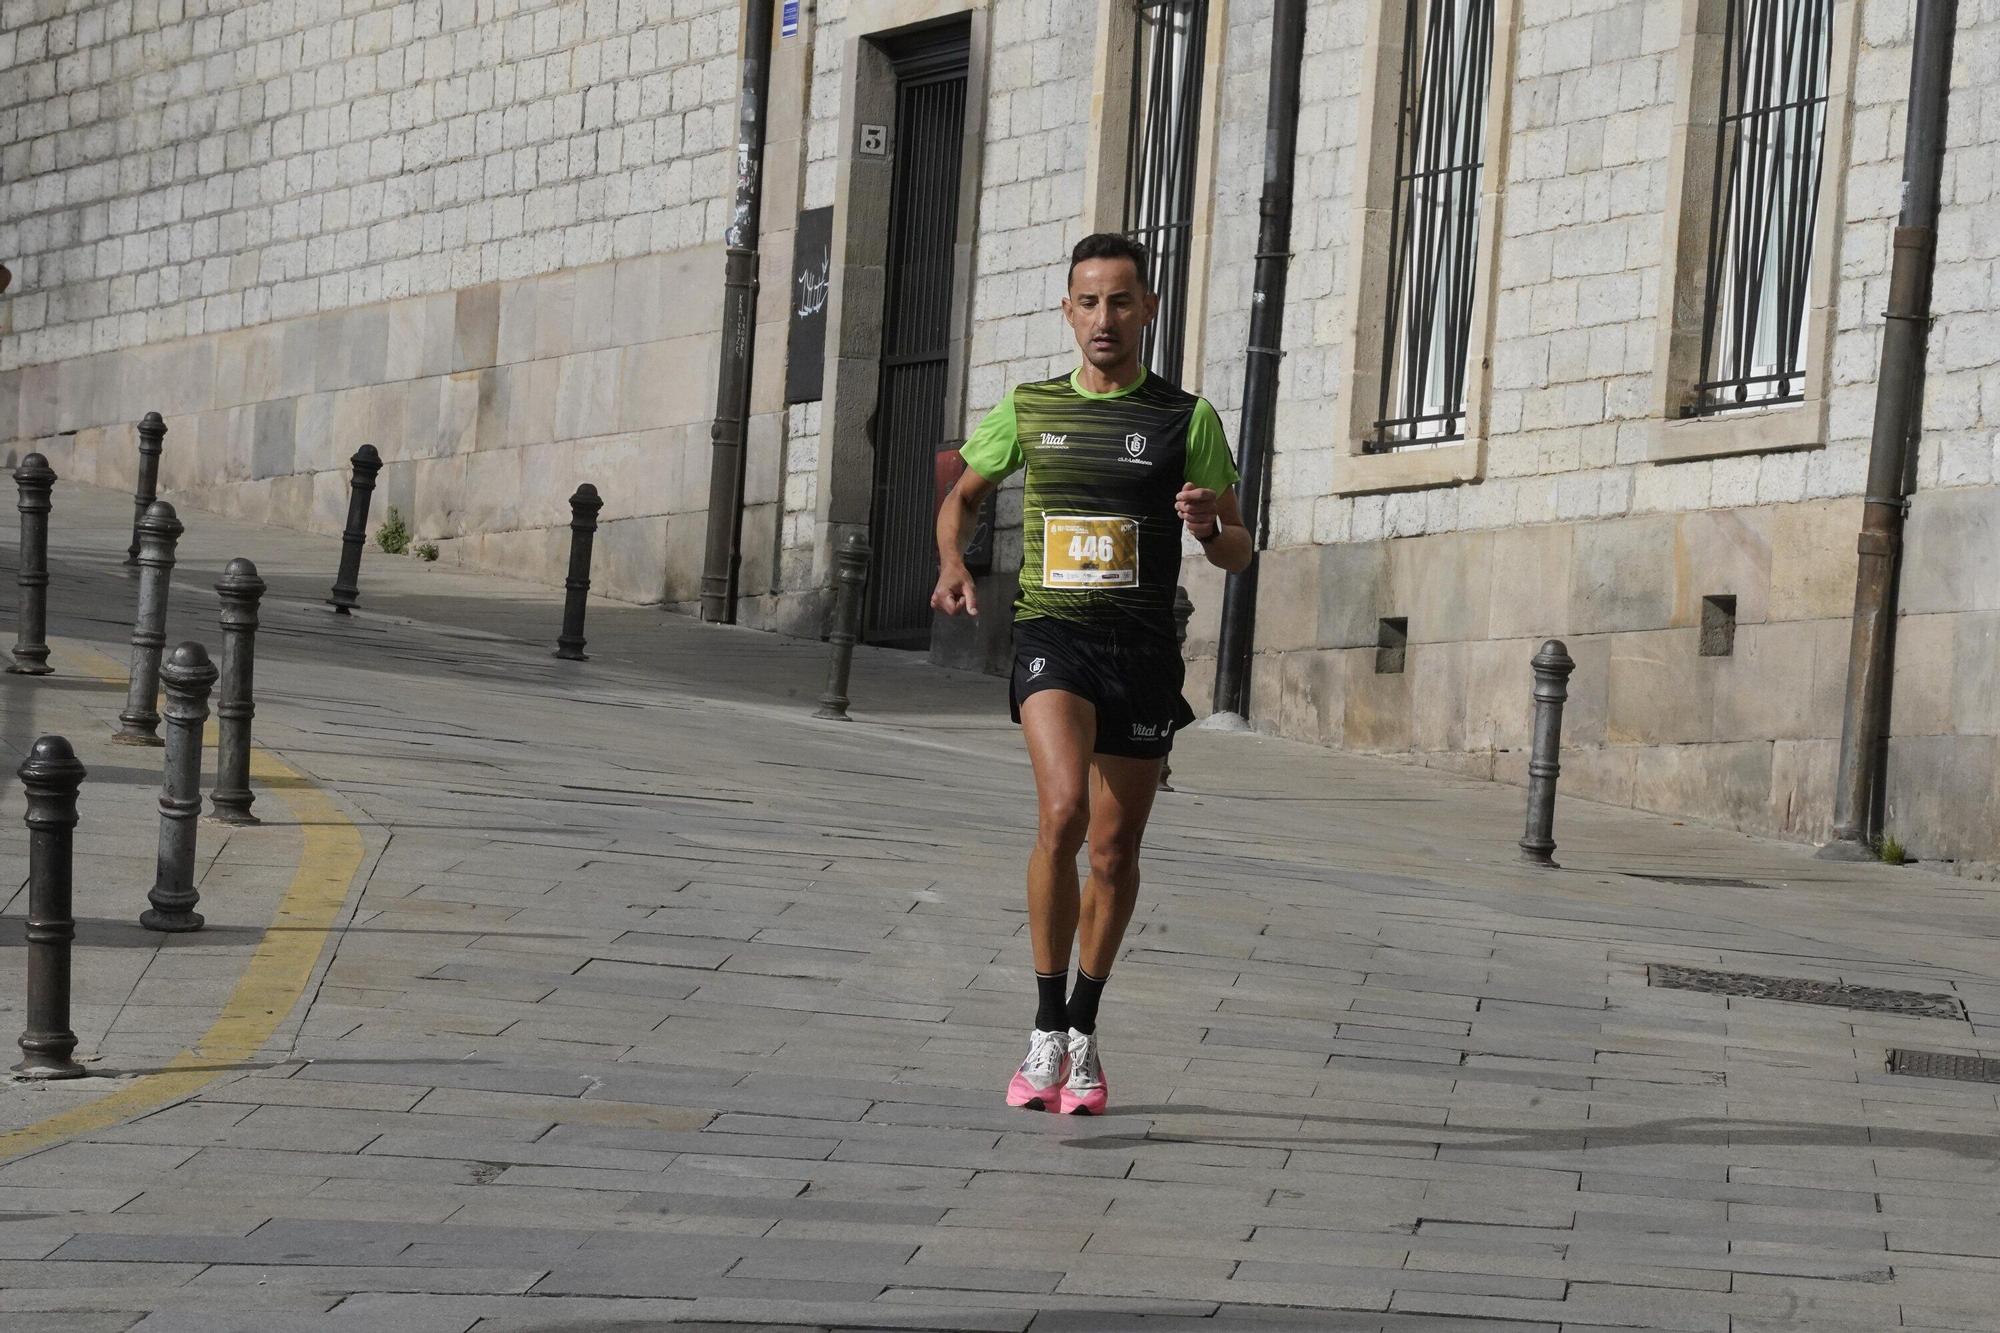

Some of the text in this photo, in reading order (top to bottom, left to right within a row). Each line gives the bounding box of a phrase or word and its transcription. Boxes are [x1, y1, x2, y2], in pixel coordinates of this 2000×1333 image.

[1040, 433, 1067, 445] Vital
[1068, 535, 1113, 562] 446
[1131, 723, 1157, 736] Vital
